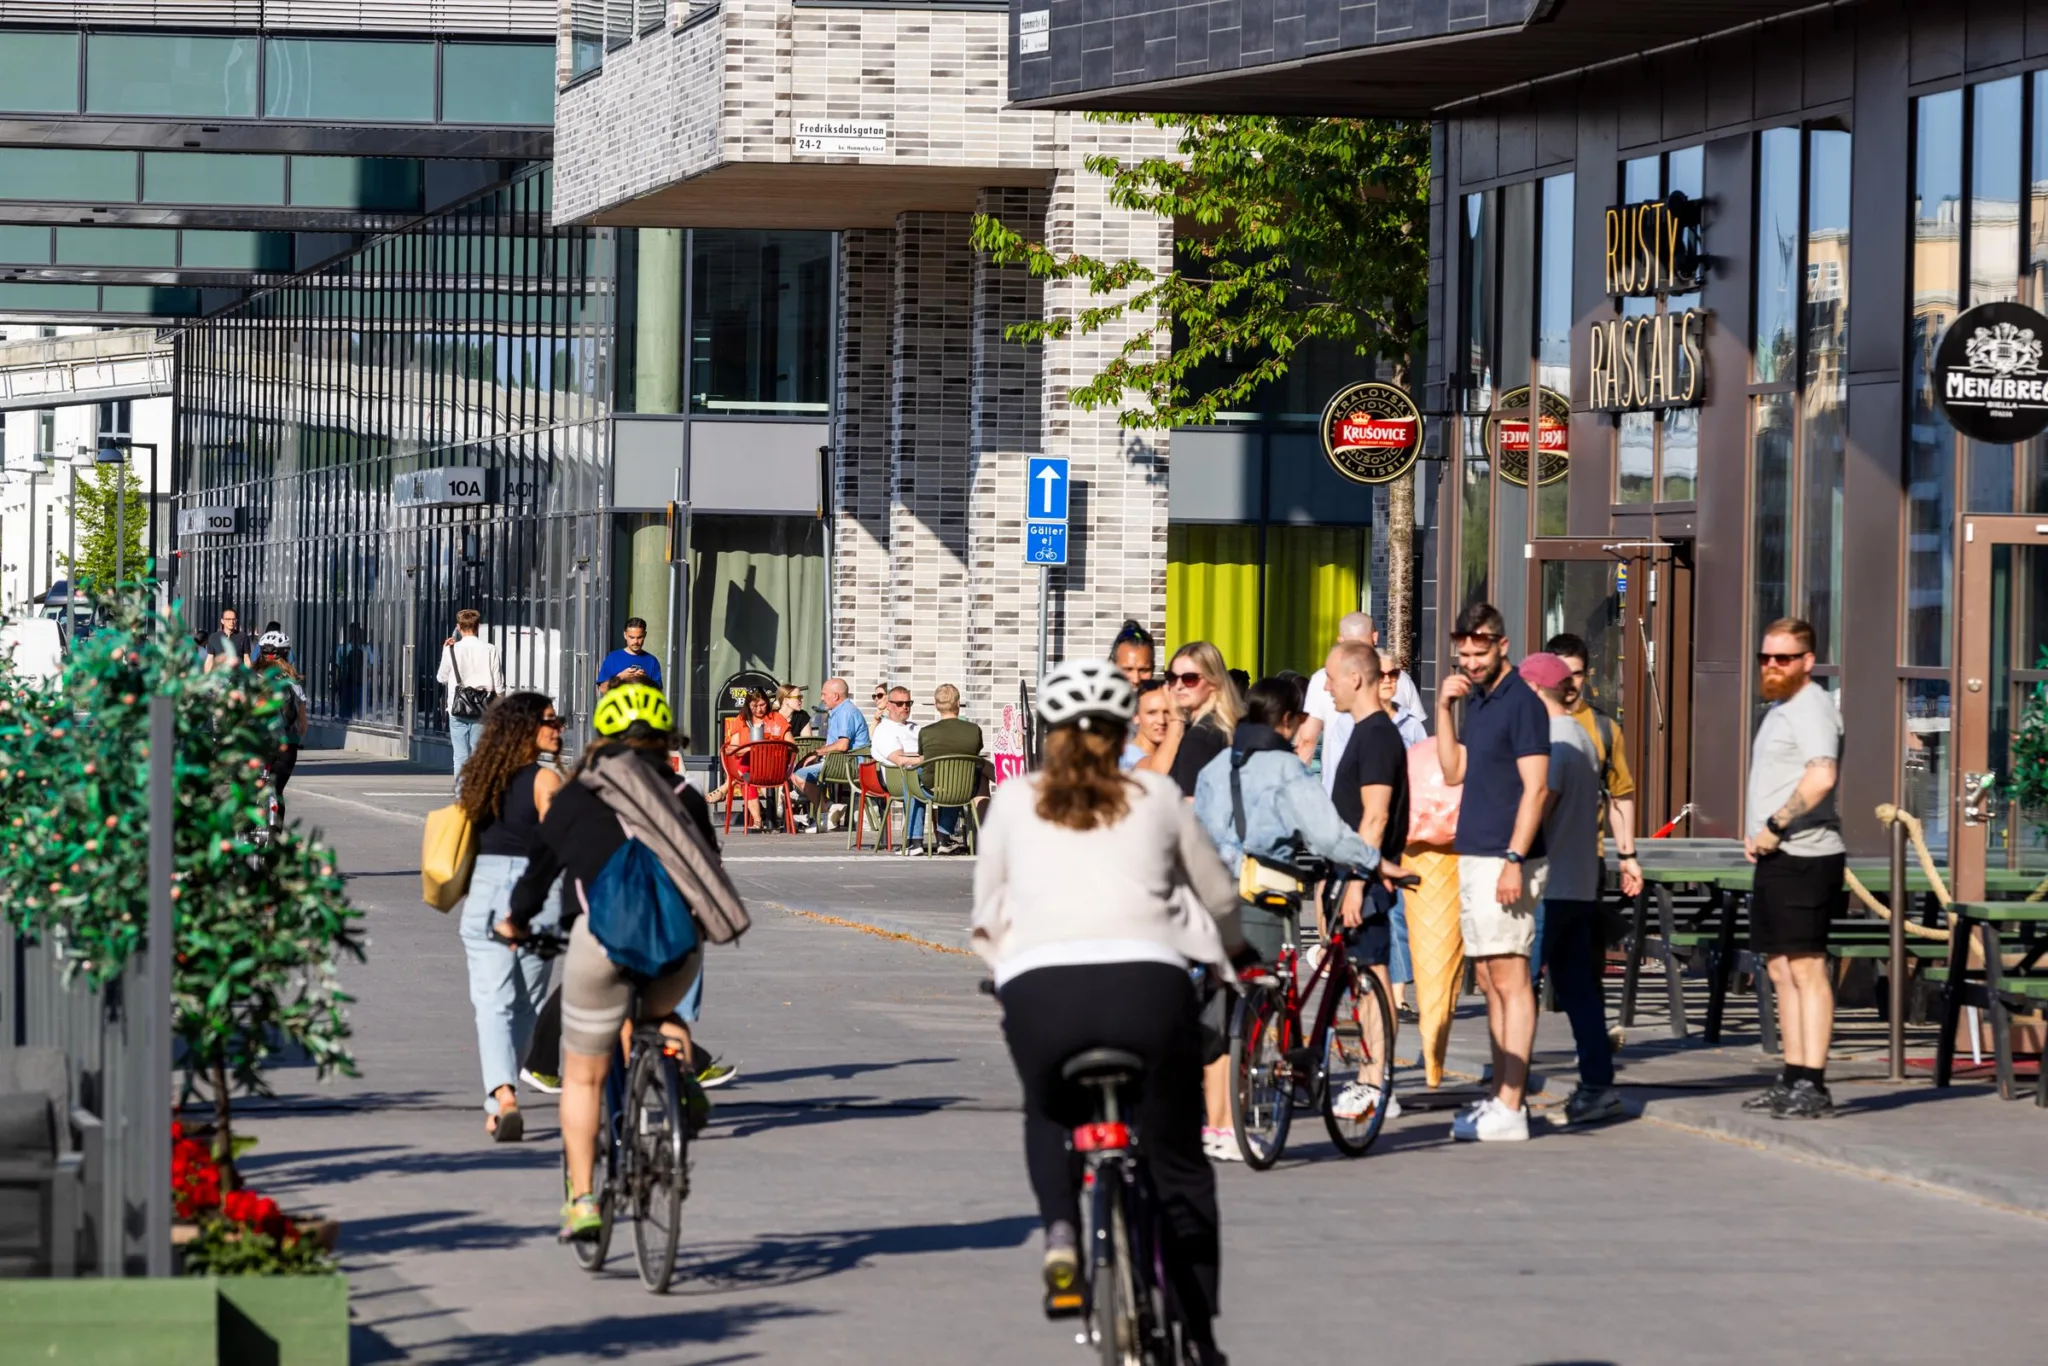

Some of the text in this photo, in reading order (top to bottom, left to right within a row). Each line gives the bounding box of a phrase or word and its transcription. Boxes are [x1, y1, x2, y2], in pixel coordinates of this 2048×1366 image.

[799, 123, 884, 137] Fredriksdalsgatan
[799, 139, 822, 149] 24-2
[1605, 202, 1679, 294] RUSTY
[1589, 311, 1696, 410] RASCALS
[1371, 461, 1401, 476] 1581
[448, 480, 482, 497] 10A
[208, 516, 233, 528] 10D
[1030, 526, 1064, 535] Gäller
[1041, 536, 1053, 546] ej
